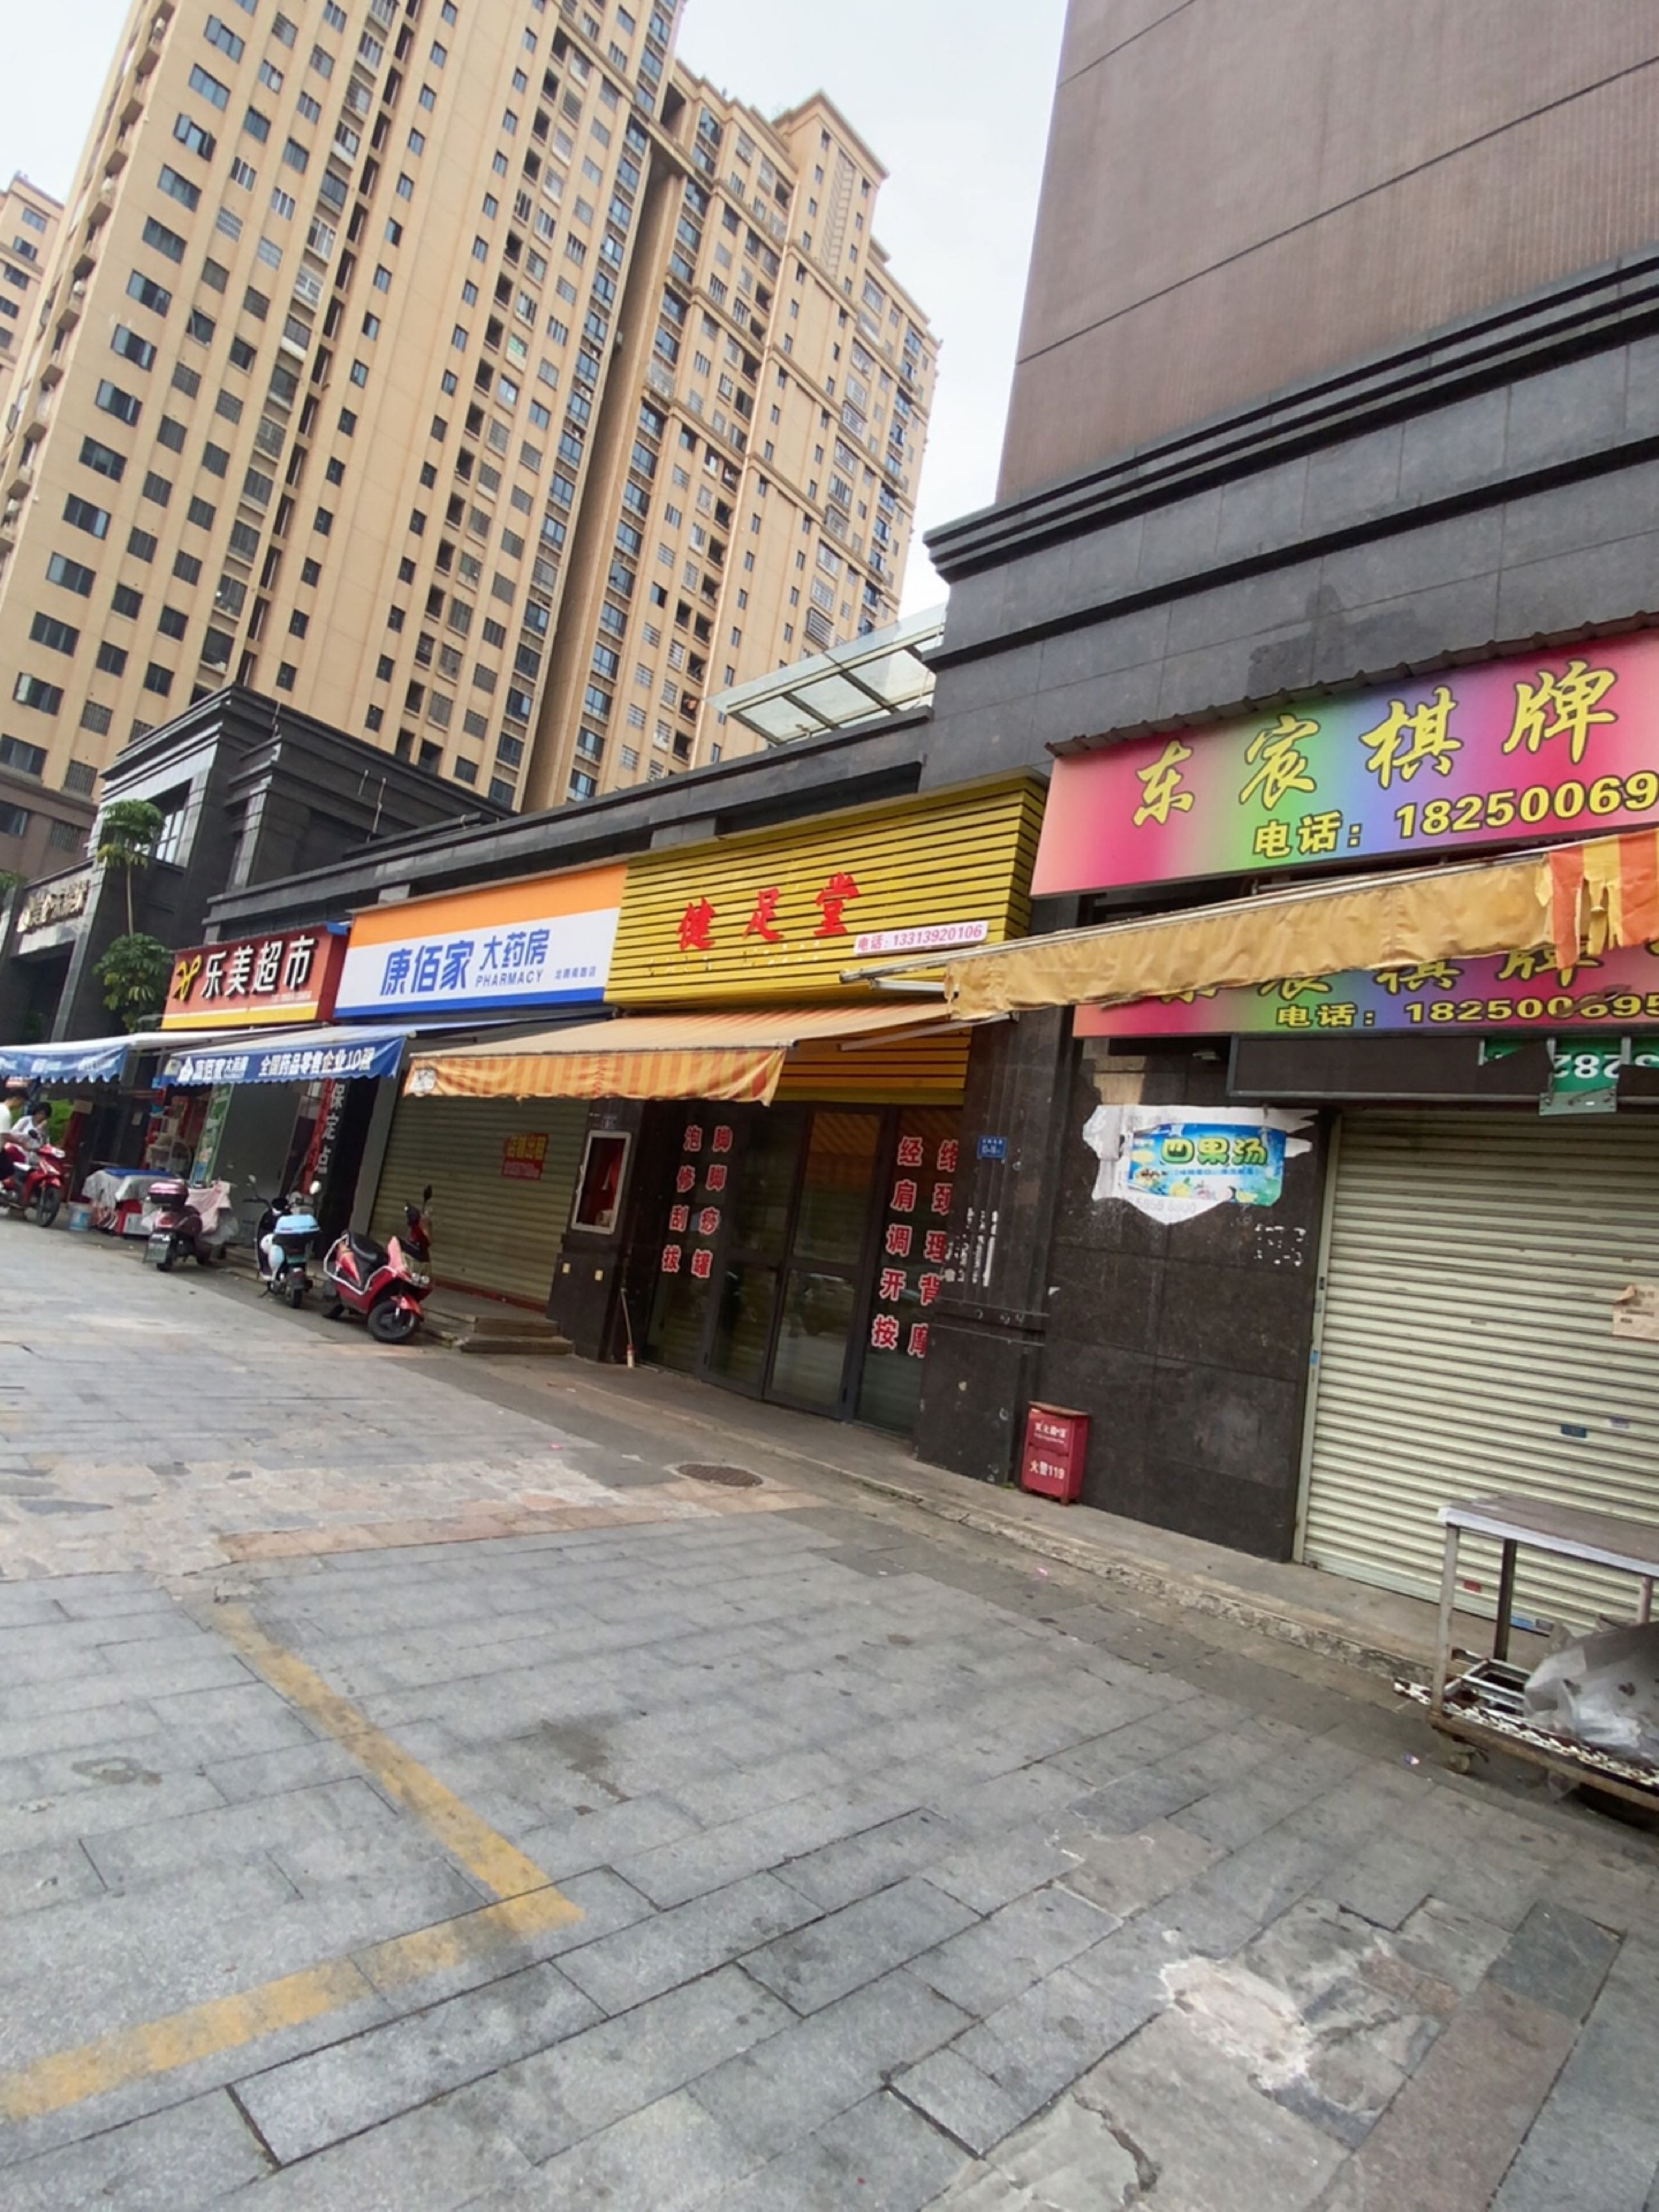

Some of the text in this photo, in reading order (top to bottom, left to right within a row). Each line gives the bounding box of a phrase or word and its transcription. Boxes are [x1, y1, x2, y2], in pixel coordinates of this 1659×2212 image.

[677, 871, 859, 952] 健足堂
[200, 934, 317, 1000] 乐美超市
[475, 968, 543, 988] PHARMACY
